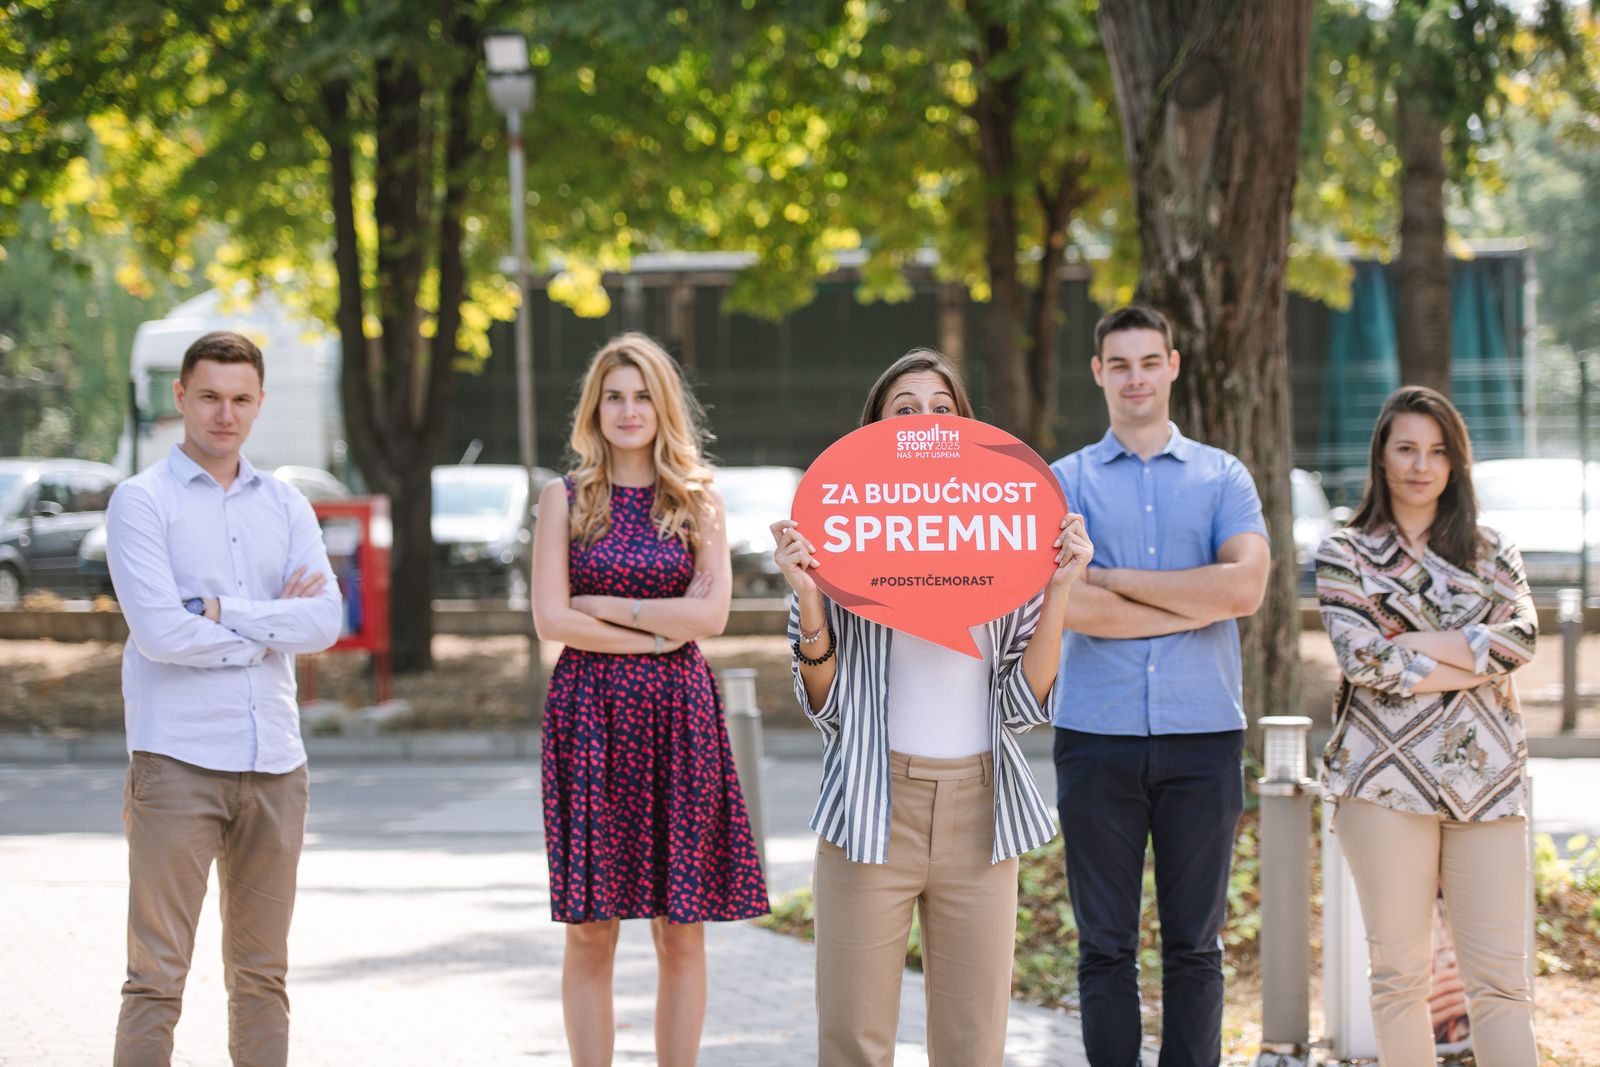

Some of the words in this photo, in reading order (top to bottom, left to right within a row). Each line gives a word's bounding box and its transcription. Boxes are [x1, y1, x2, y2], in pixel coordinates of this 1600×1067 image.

[896, 441, 934, 451] STORY
[935, 441, 960, 450] 2025
[896, 451, 912, 459] NAŠ
[915, 451, 930, 459] PUT
[931, 451, 960, 459] USPEHA
[821, 483, 859, 505] ZA
[865, 477, 1037, 504] BUDUĆNOST
[822, 514, 1037, 553] SPREMNI
[870, 574, 994, 587] #PODSTIČEMORAST
